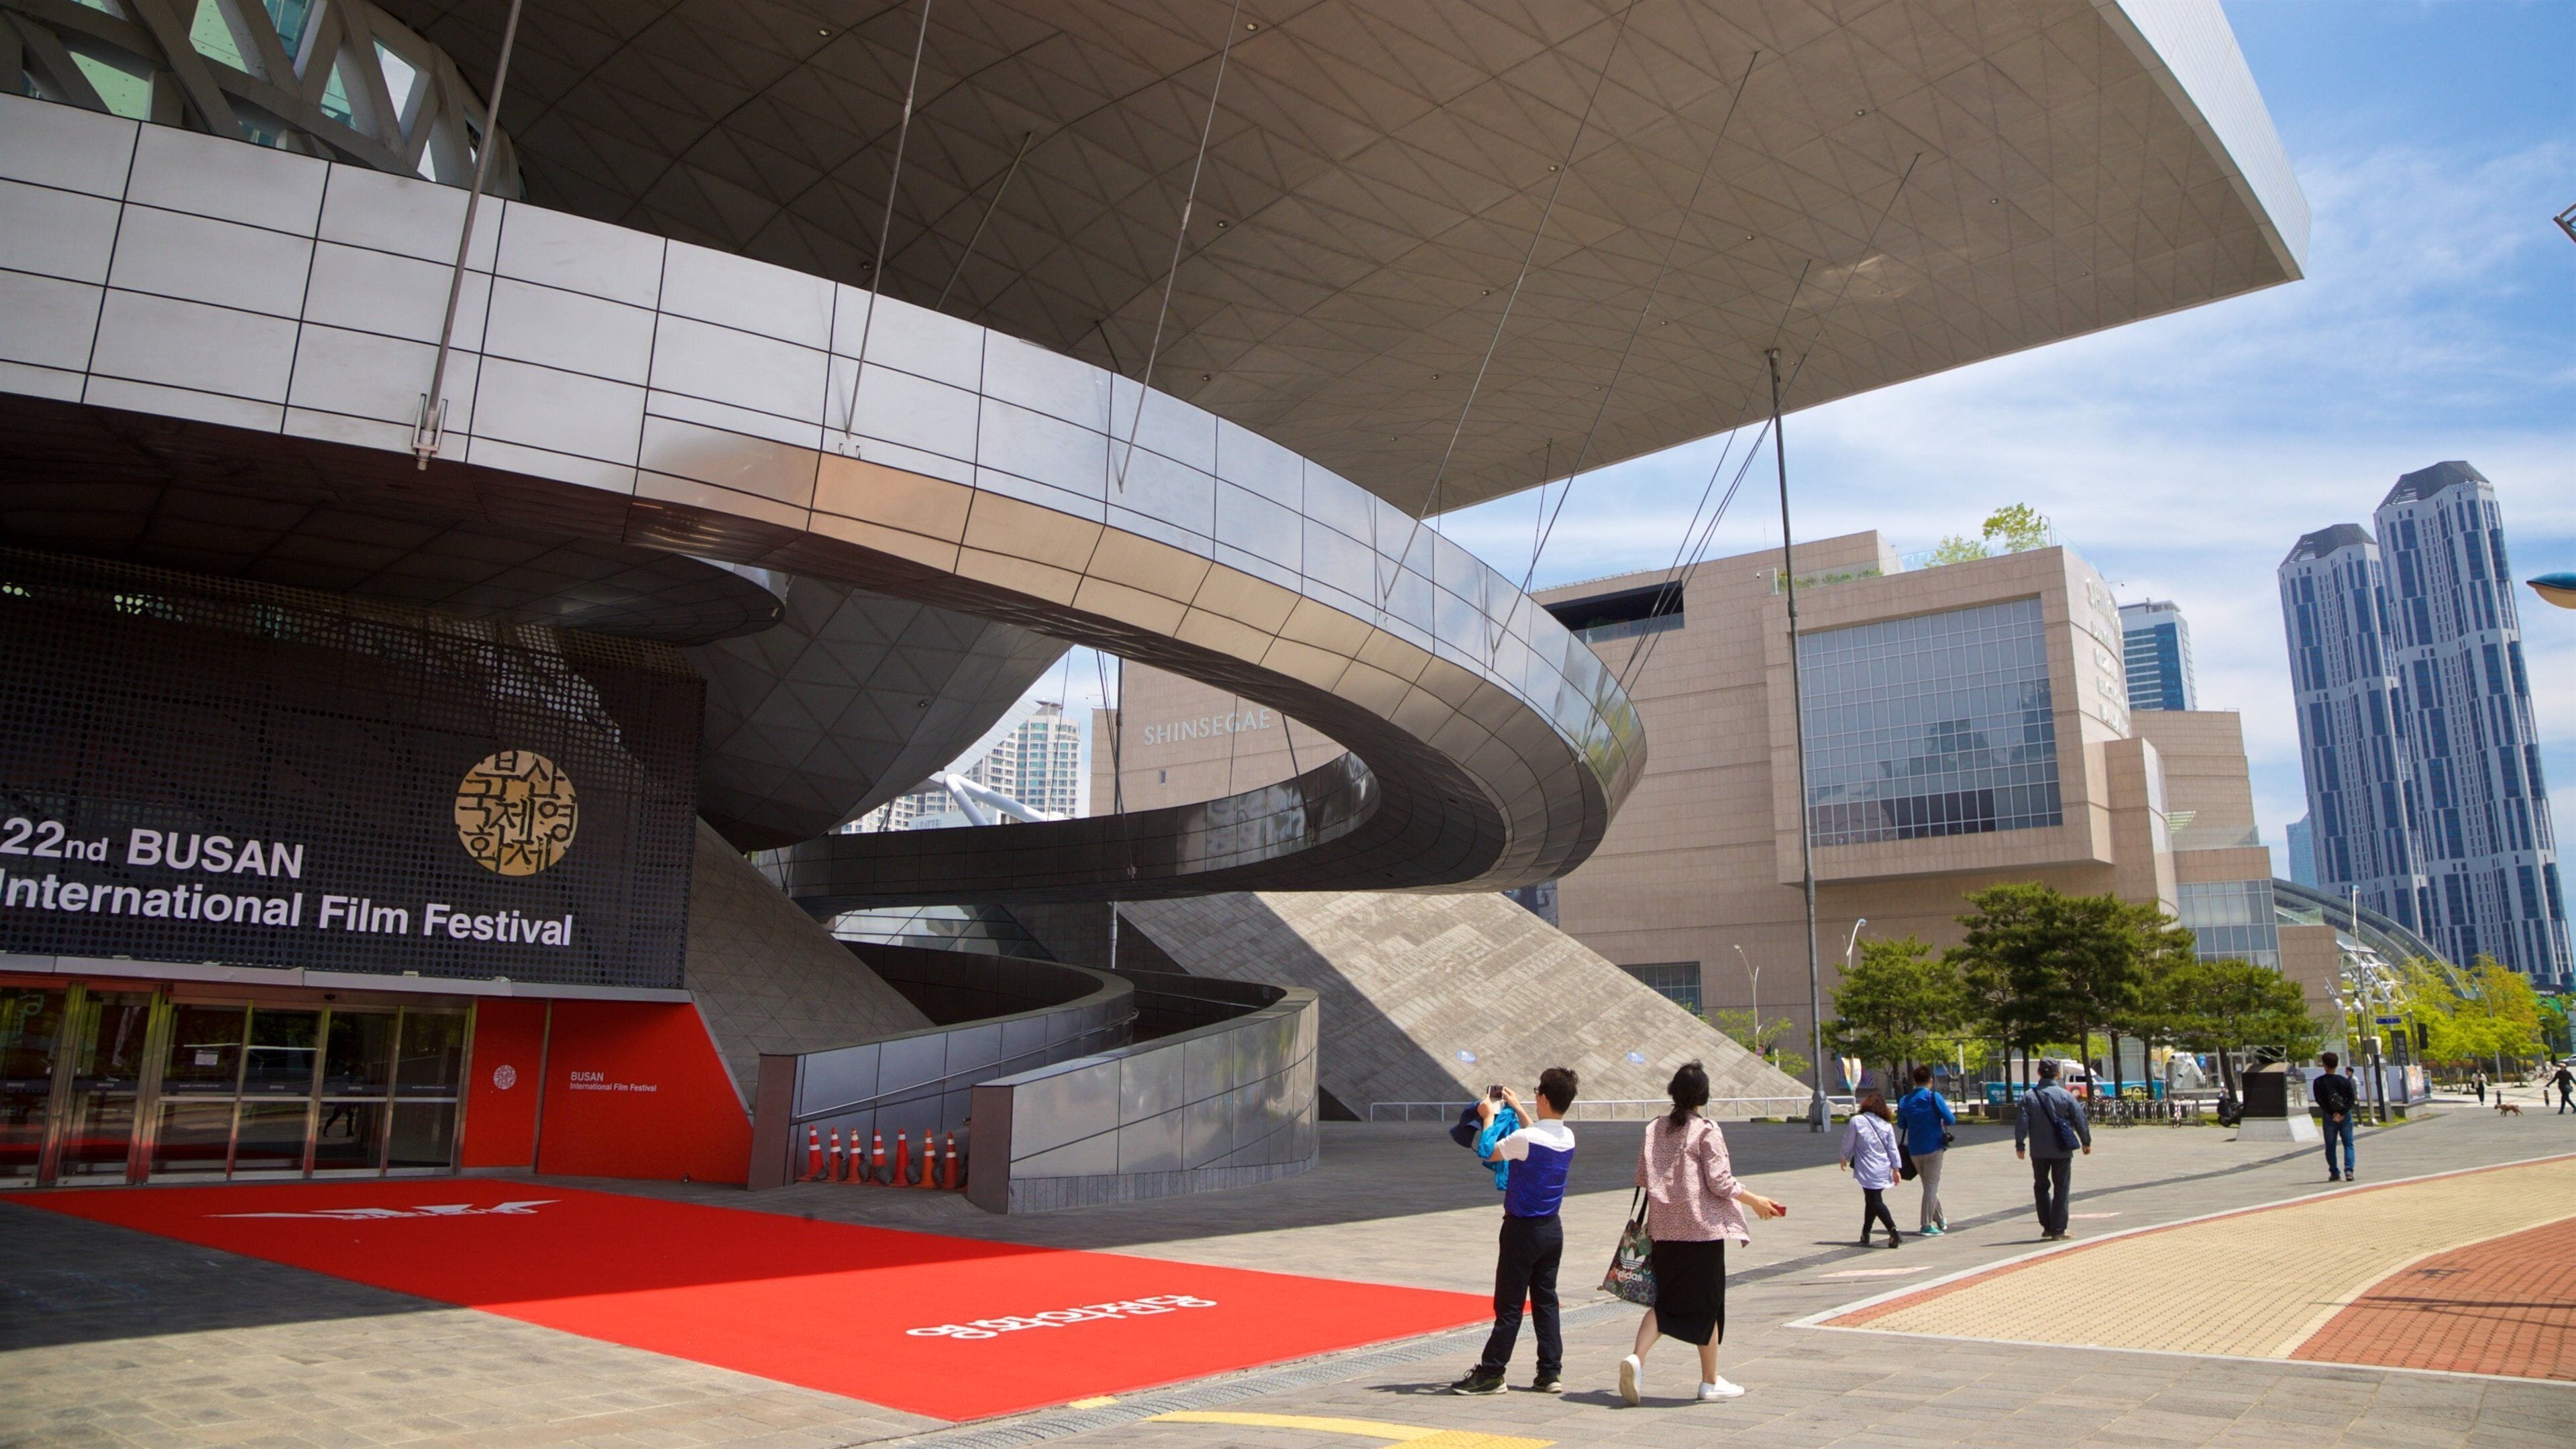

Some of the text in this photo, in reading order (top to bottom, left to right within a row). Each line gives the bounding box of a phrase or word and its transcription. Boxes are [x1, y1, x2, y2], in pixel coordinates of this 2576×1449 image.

[1144, 708, 1271, 746] SHINSEGAE
[0, 817, 304, 879] 22nd BUSAN
[0, 869, 573, 946] nternational Film Festival
[570, 1081, 657, 1092] International Film Festival
[571, 1071, 604, 1081] BUSAN
